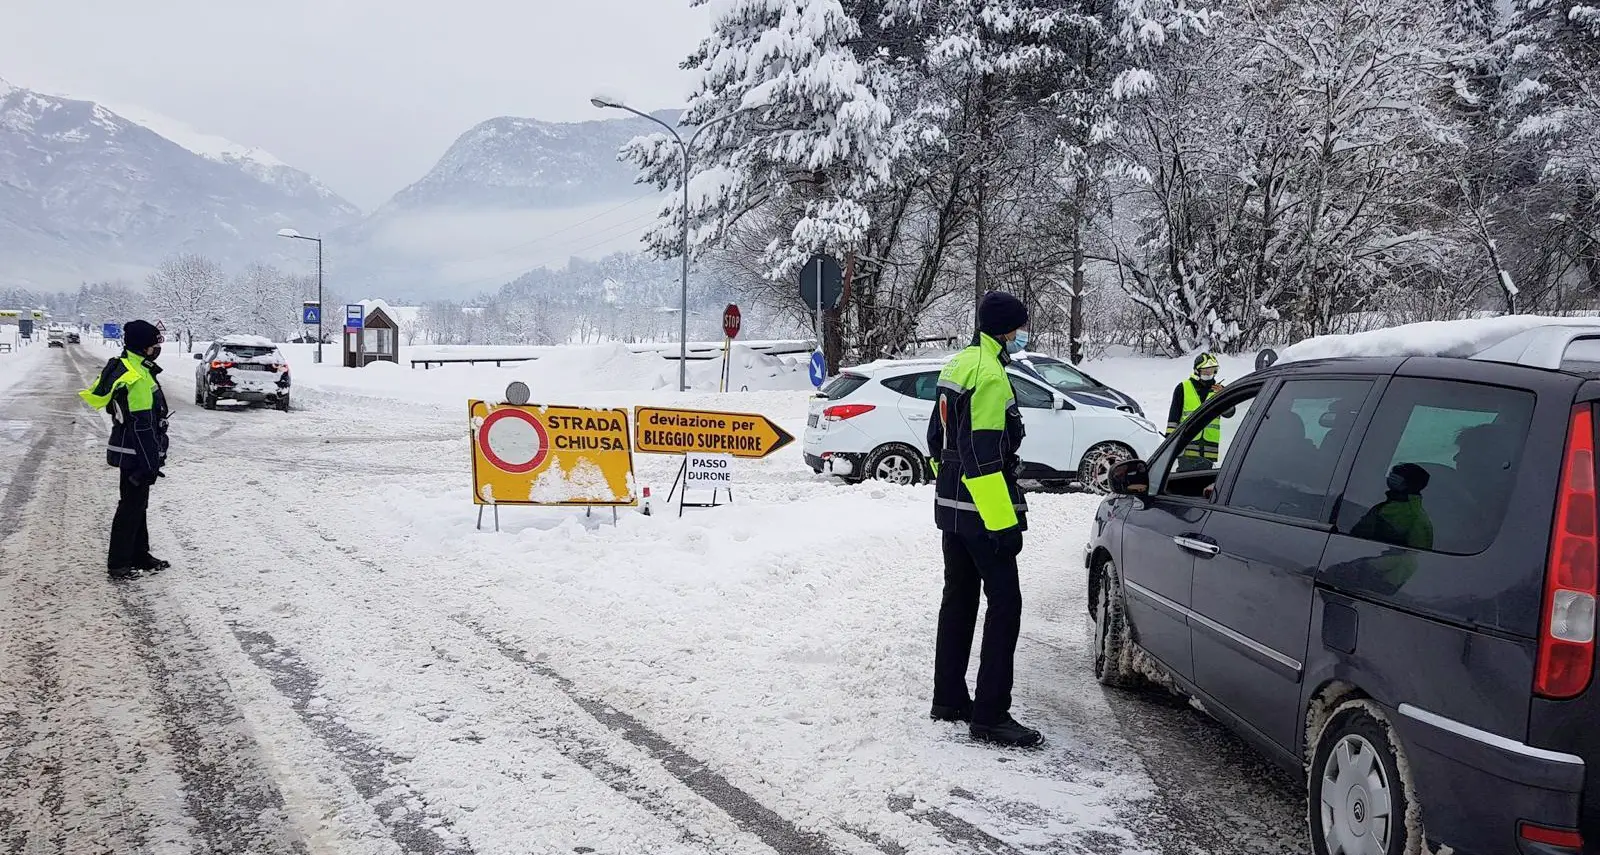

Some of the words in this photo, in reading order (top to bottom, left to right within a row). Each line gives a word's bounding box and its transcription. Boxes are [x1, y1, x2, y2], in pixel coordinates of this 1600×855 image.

[725, 314, 739, 328] STOP
[548, 415, 622, 432] STRADA
[649, 413, 726, 429] deviazione
[732, 420, 755, 432] per
[555, 435, 624, 451] CHIUSA
[644, 430, 695, 448] BLEGGIO
[697, 433, 762, 451] SUPERIORE
[692, 459, 727, 469] PASSO
[688, 471, 731, 481] DURONE
